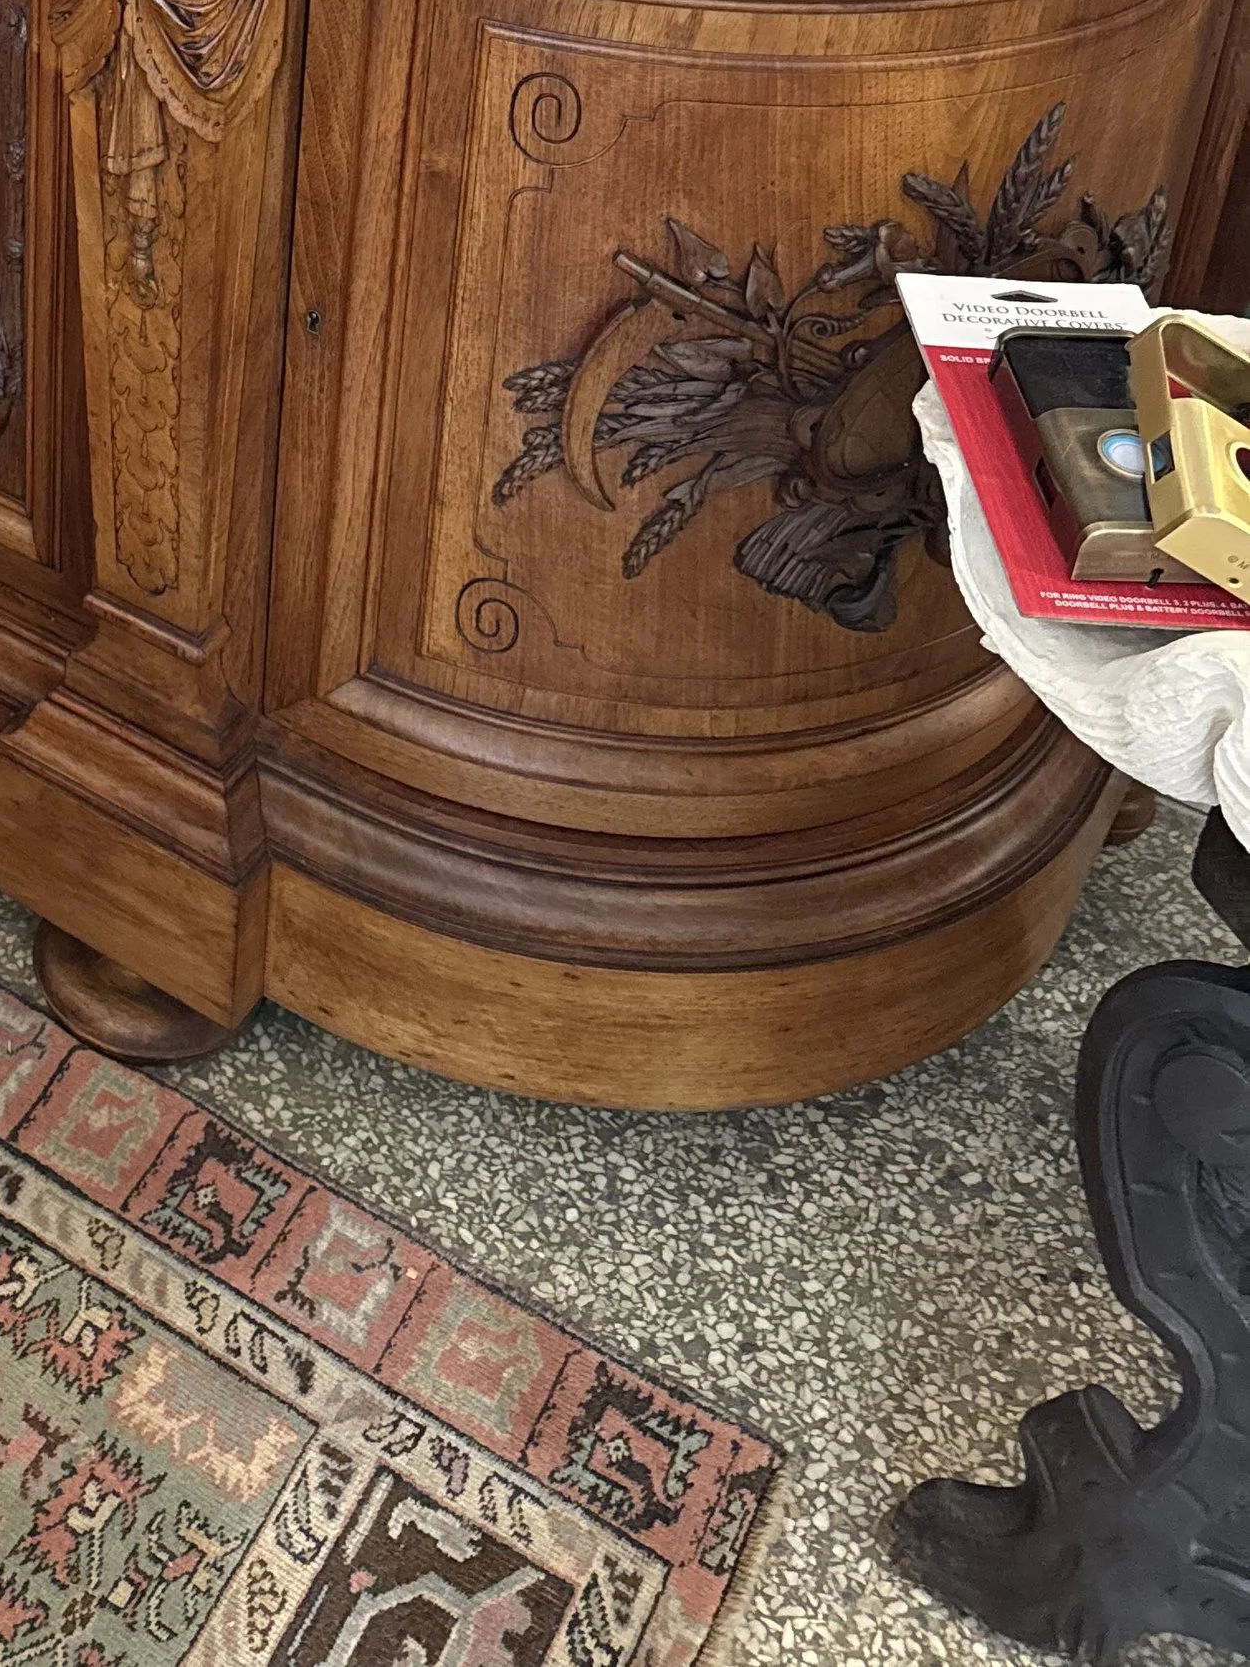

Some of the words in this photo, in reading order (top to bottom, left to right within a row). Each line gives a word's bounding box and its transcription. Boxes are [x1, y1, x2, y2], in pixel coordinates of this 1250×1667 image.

[952, 303, 1009, 314] VIDEO
[1015, 307, 1108, 318] DOORBELL
[942, 314, 1049, 327] DECORATIVE
[940, 355, 974, 363] SOLID
[1040, 591, 1061, 599] FOR
[1119, 596, 1172, 606] DOORBELL
[1055, 600, 1108, 610] DOORBELL
[1109, 603, 1134, 611] PLUS
[1145, 605, 1188, 614] BATTERY
[1190, 608, 1244, 617] DOORBELL
